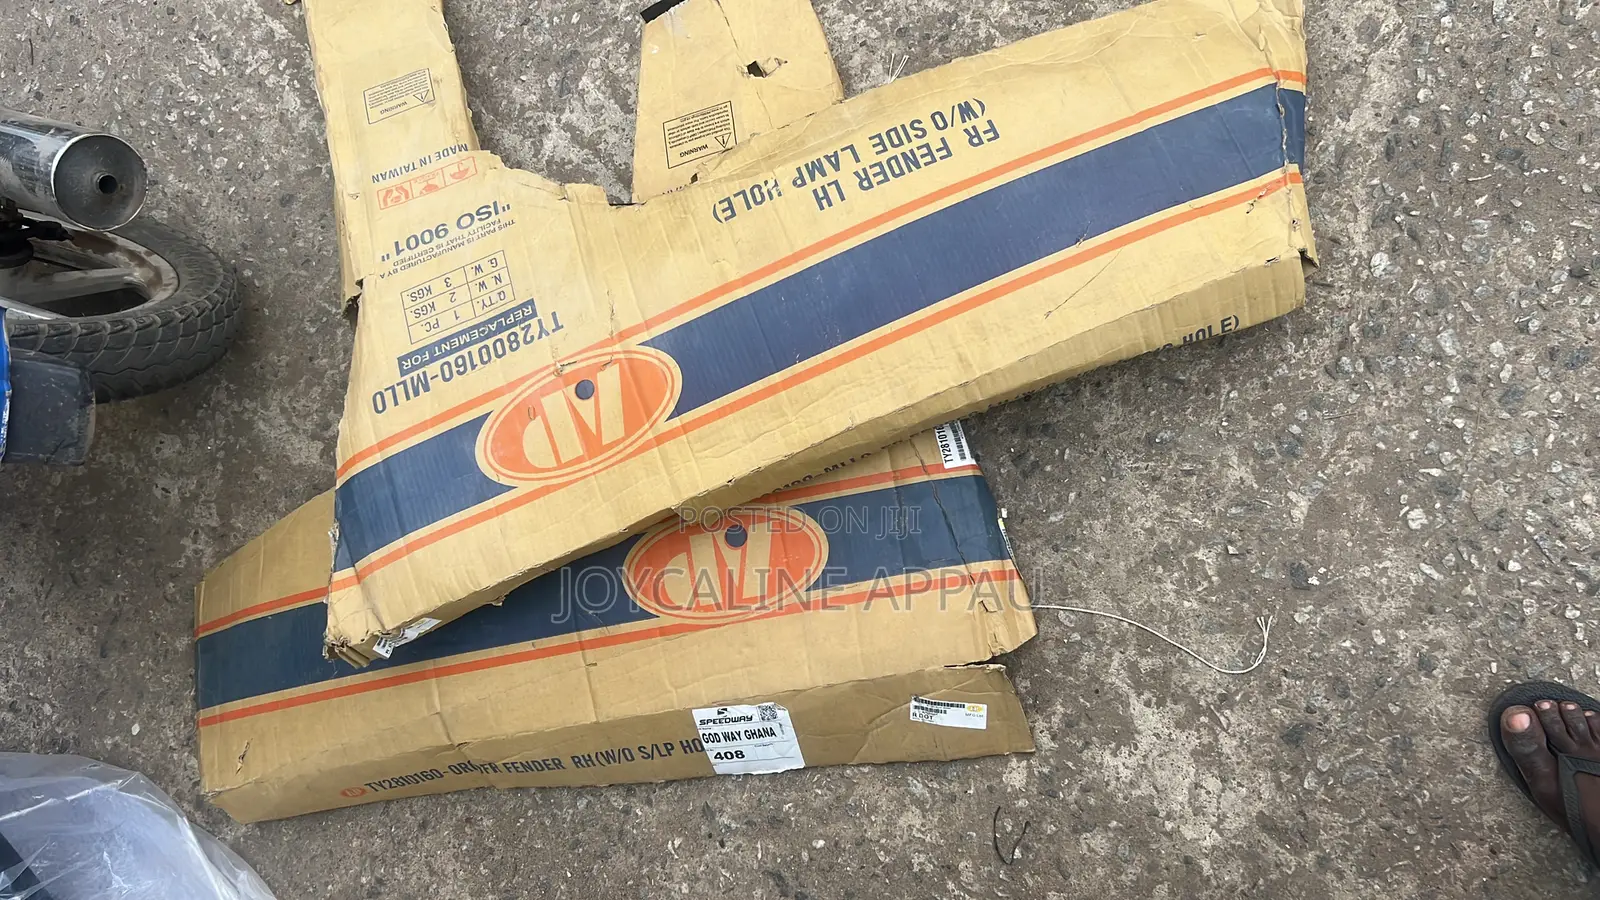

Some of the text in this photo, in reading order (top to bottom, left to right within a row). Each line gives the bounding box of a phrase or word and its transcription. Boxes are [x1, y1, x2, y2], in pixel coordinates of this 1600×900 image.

[435, 143, 469, 161] MADE
[679, 143, 709, 158] WARNING
[419, 155, 432, 168] IN
[712, 97, 987, 225] (W/O SIDE LAMP HOLE)
[812, 119, 1001, 211] FR FENDER LH
[371, 162, 418, 183] TAIWAN
[456, 200, 511, 230] "ISO
[479, 226, 497, 239] PART
[497, 219, 516, 231] THIS
[393, 218, 501, 267] FACILITY THAT IS CERTIFIED
[467, 234, 475, 244] IS
[400, 241, 466, 271] MANUFACTURED
[387, 267, 399, 277] BY
[471, 257, 498, 276] G. W.
[406, 277, 452, 302] 3 KGS.
[475, 273, 503, 292] N. W.
[410, 291, 457, 319] 2 KGS.
[421, 310, 460, 333] 1 PC.
[401, 304, 533, 370] REPLACEMENT FOR
[698, 715, 753, 726] SPEEDWAY
[701, 732, 721, 744] GOD
[721, 730, 741, 743] WAY
[744, 726, 777, 740] GHANA
[502, 757, 565, 776] FENDER
[638, 741, 676, 763] S/LP
[713, 750, 746, 761] 408
